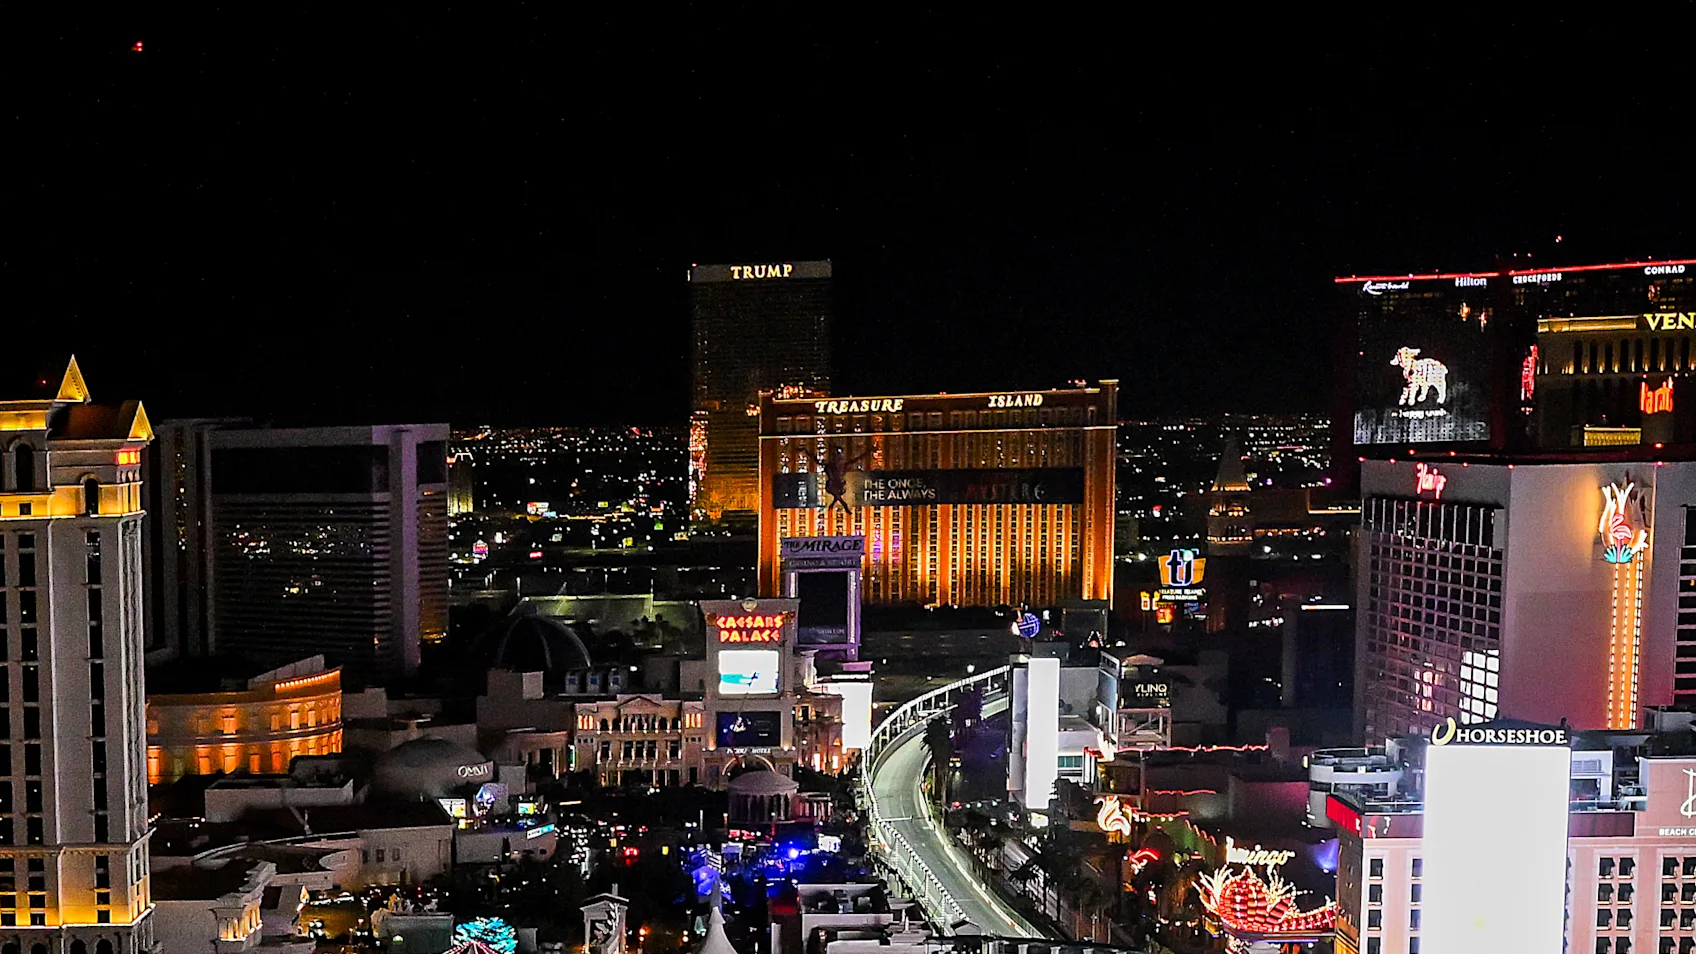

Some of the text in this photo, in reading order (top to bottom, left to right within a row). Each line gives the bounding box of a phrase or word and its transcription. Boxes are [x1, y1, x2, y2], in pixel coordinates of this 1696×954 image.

[731, 264, 793, 280] TRUMP
[1644, 265, 1686, 275] CONRAD
[1455, 276, 1487, 287] Hilton
[1513, 273, 1562, 284] CROCKFORDS
[1643, 312, 1696, 331] VEN
[815, 394, 1044, 414] TREASURE ISLAND
[864, 479, 885, 489] THE
[864, 488, 936, 501] THE ALWAYS
[792, 540, 862, 552] MIRAGE
[716, 615, 784, 629] CAESARS
[719, 630, 780, 643] PALACE
[1659, 828, 1687, 836] BEACH
